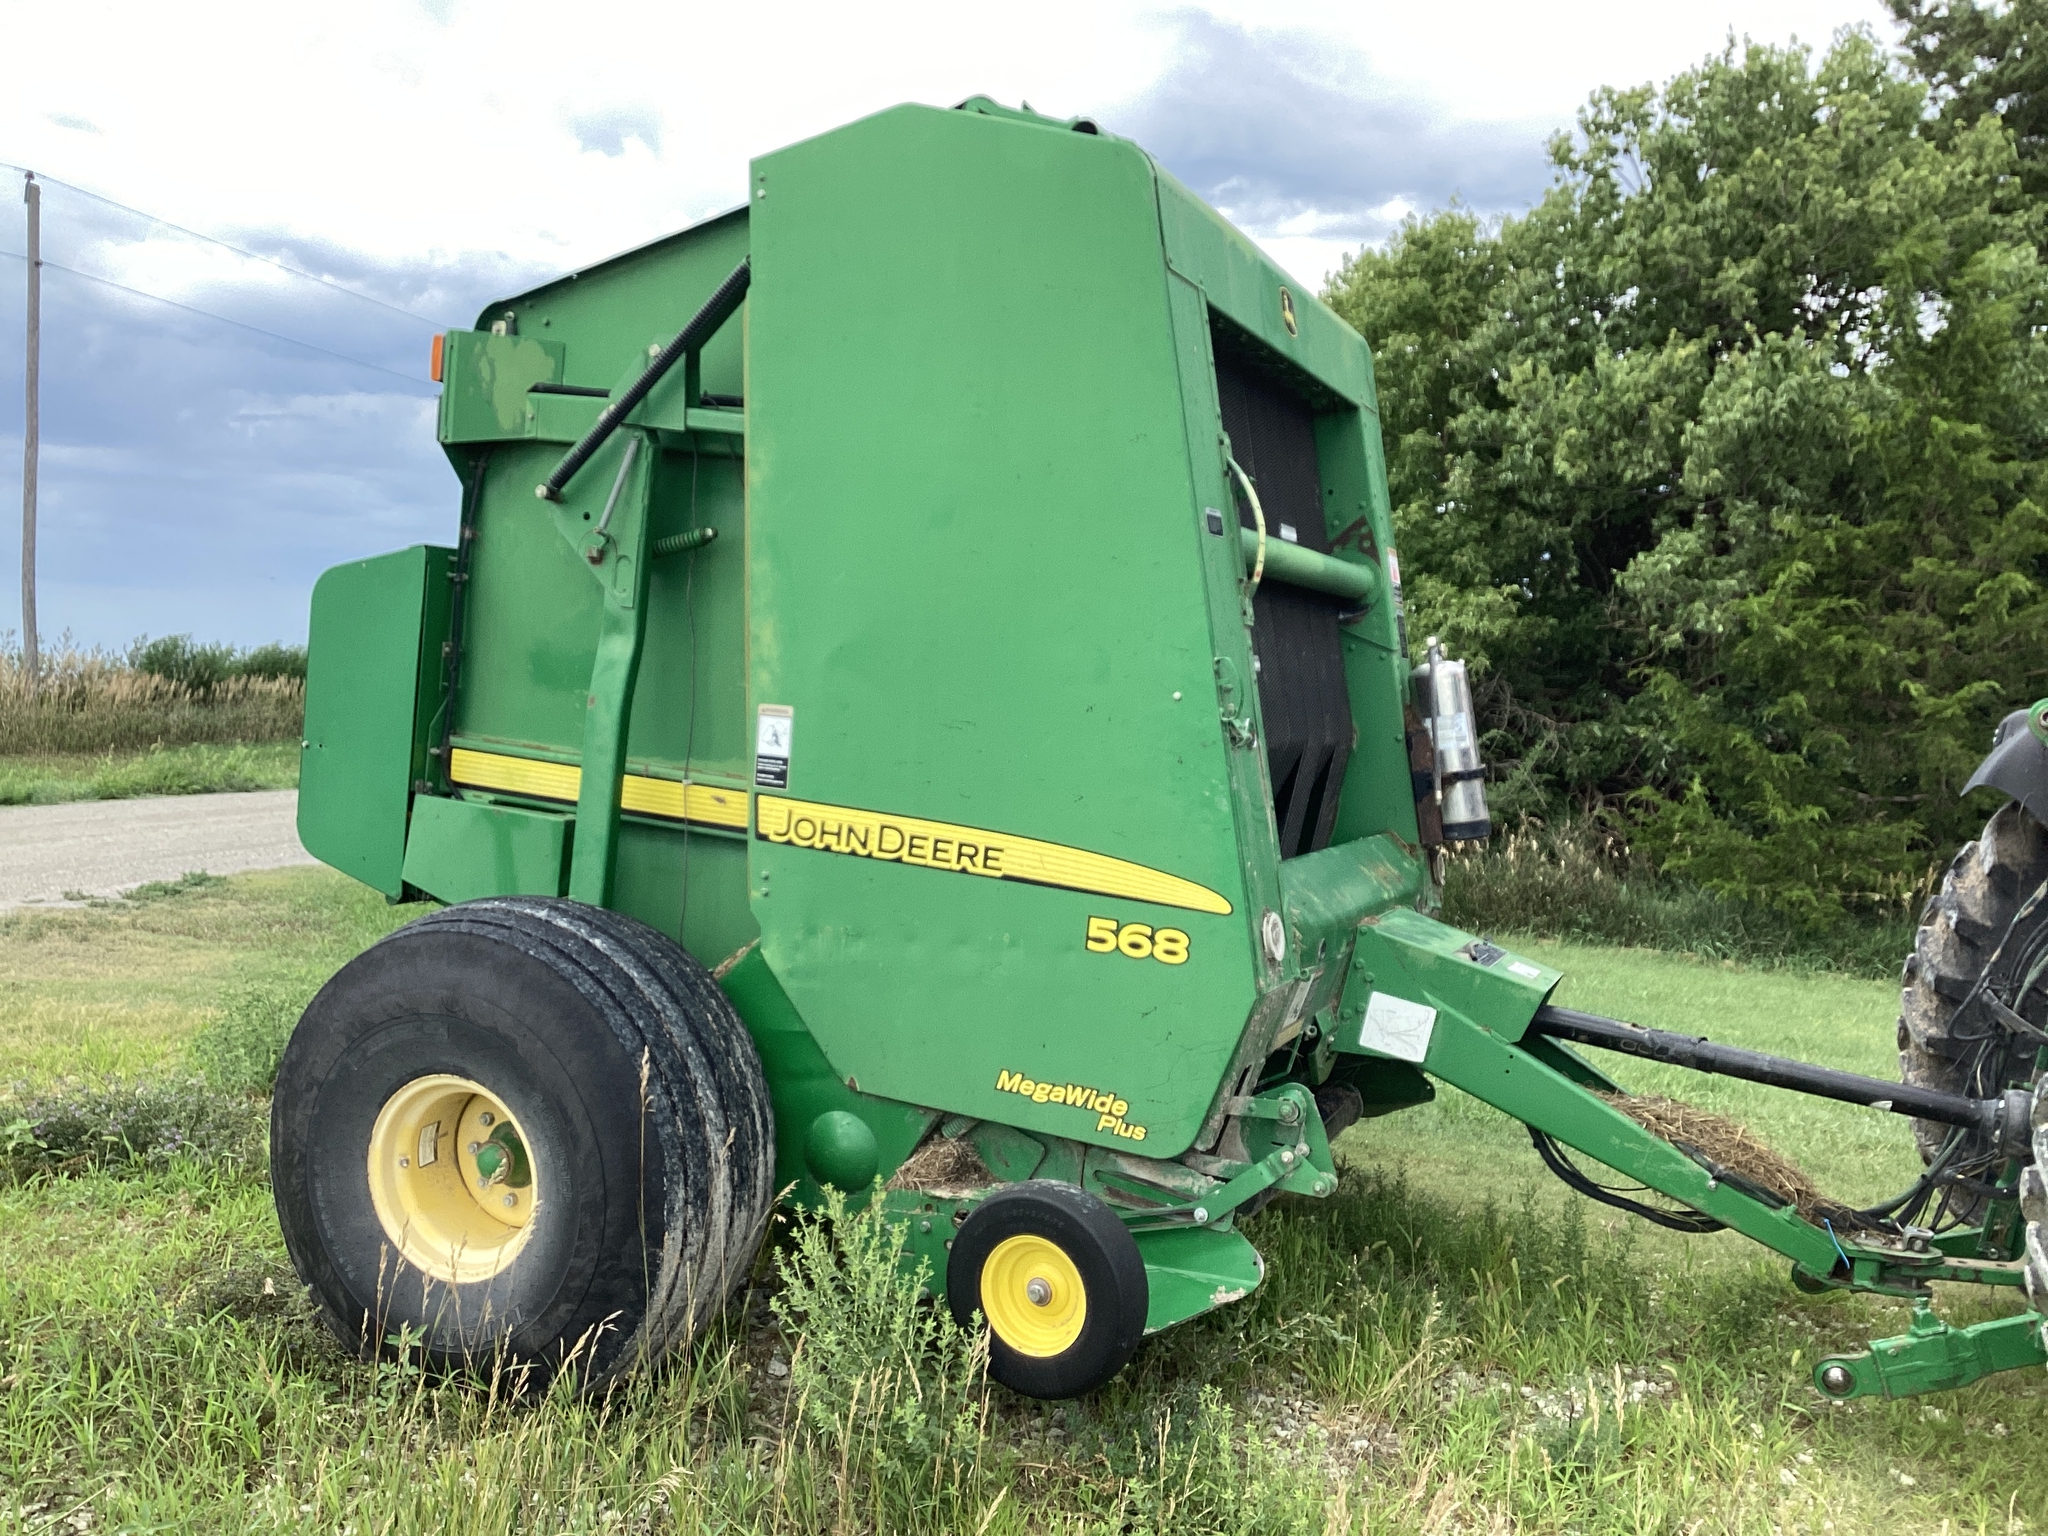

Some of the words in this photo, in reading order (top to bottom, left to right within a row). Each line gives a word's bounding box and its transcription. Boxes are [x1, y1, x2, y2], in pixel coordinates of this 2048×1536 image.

[774, 809, 869, 850] JOHN
[877, 823, 1005, 872] DEERE
[1085, 915, 1191, 965] 568
[994, 1068, 1129, 1117] MegaWide
[1095, 1113, 1148, 1141] Plus
